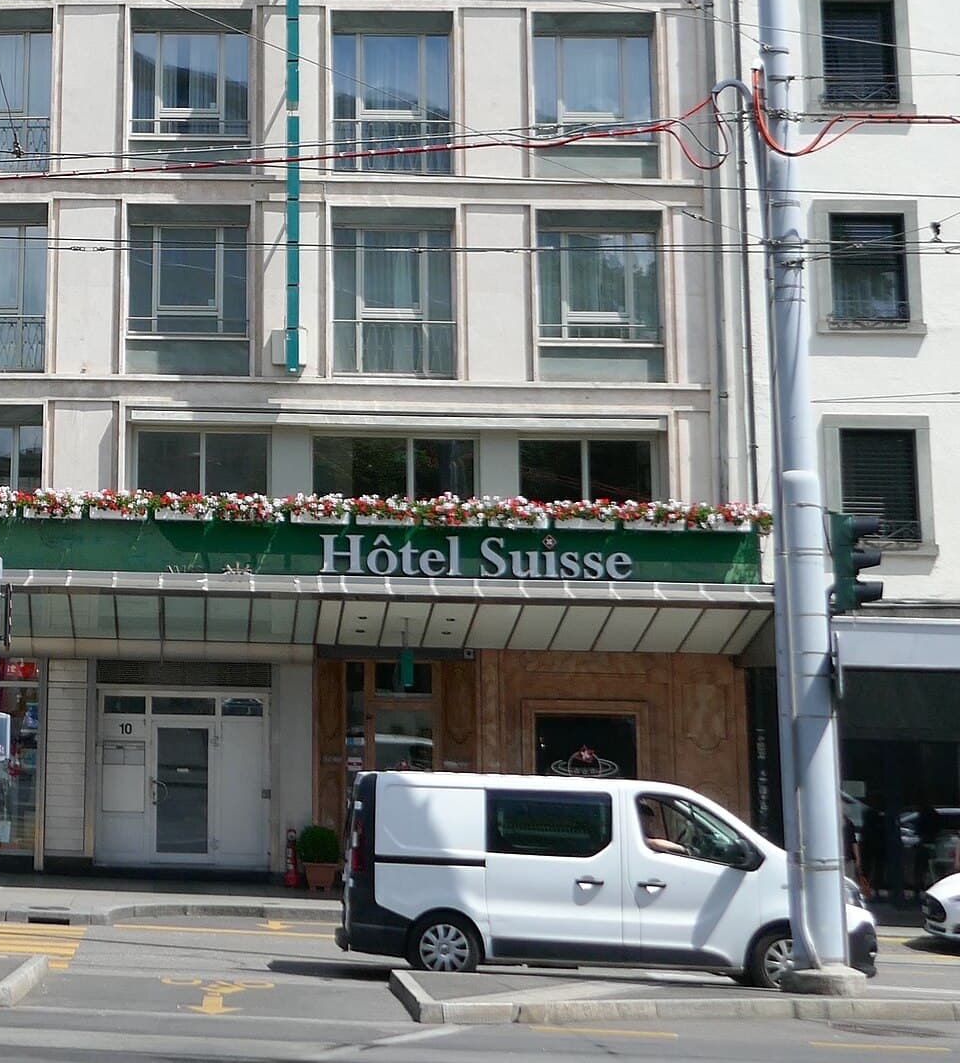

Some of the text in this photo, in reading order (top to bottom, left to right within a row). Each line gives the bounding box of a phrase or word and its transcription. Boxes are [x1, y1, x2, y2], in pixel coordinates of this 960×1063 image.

[319, 533, 632, 579] Hôtel Suisse
[119, 722, 133, 735] 10
